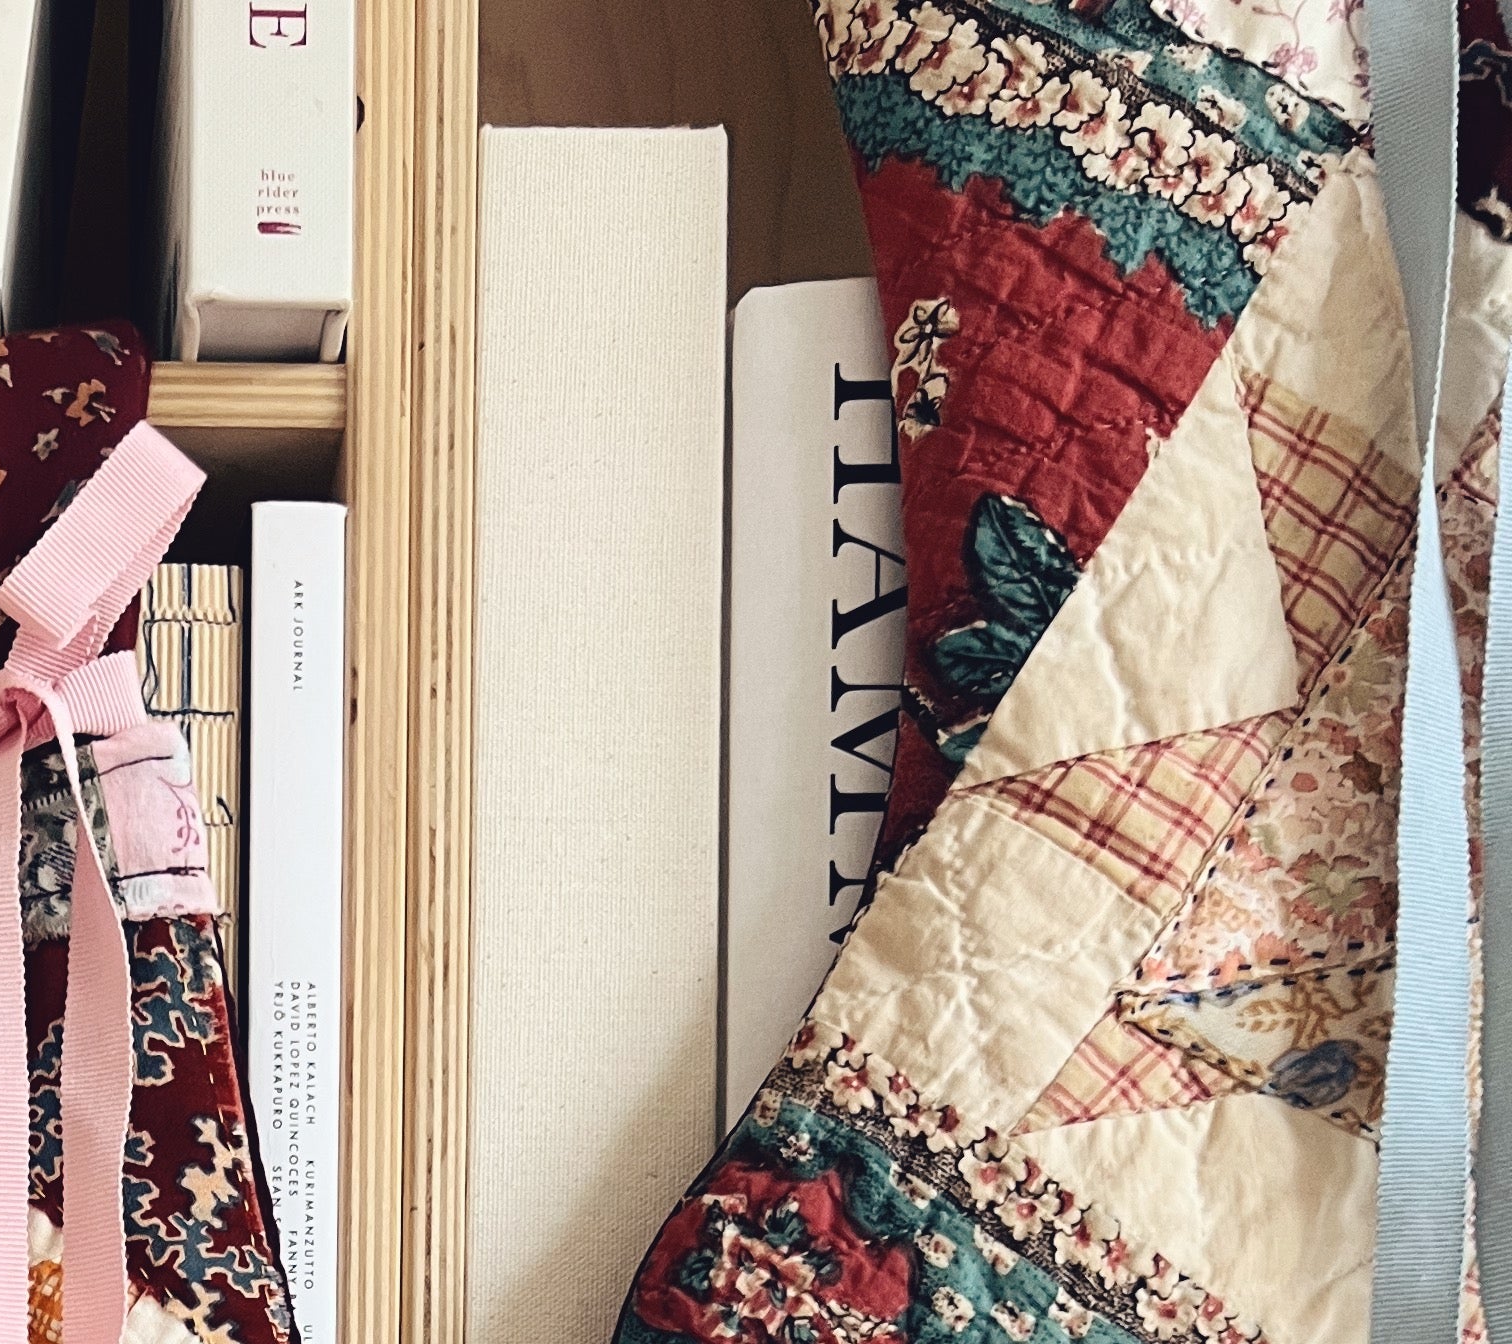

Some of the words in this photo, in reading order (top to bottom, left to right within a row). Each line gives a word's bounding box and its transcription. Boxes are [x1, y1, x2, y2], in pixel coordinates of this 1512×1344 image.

[257, 186, 299, 199] rider
[260, 169, 296, 182] blue
[256, 203, 300, 217] press
[294, 580, 304, 610] ARK
[293, 618, 304, 691] JOURNAL
[290, 982, 300, 1032] DAVID
[306, 982, 316, 1052] ALBERTO
[272, 1031, 283, 1131] KUKKAPURO
[290, 1040, 300, 1089] LOPEZ
[306, 1061, 316, 1126] KALACH
[288, 1098, 299, 1197] QUINCOCES
[304, 1160, 315, 1290] KURIMANZUTTO
[288, 1230, 297, 1285] FANNY
